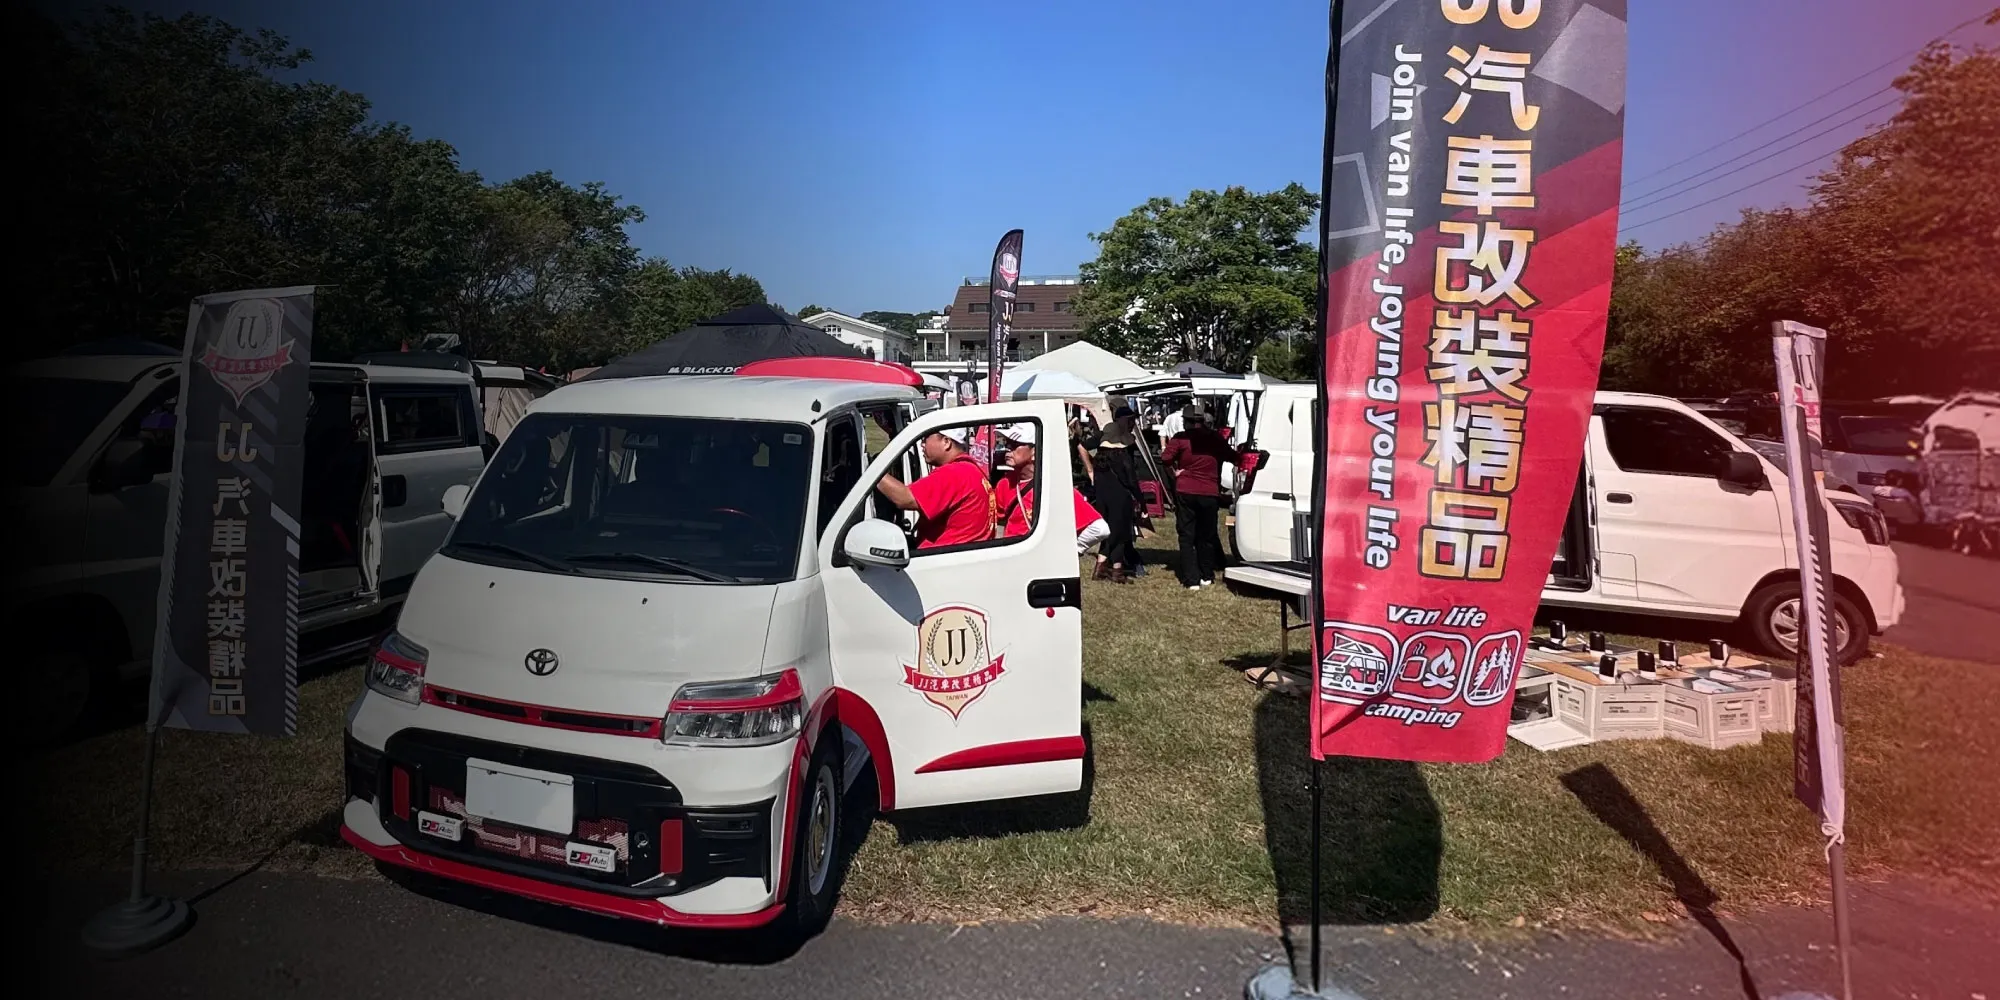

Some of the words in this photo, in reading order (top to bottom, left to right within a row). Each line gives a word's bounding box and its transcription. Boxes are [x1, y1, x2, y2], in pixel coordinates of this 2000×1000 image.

[1391, 44, 1422, 121] Join
[1387, 130, 1412, 197] van
[1421, 44, 1540, 580] 汽車改裝精品
[681, 366, 724, 374] BLACK
[1366, 407, 1395, 499] your
[1366, 507, 1397, 568] life
[1387, 605, 1441, 626] van
[1442, 606, 1487, 628] life
[941, 627, 968, 667] JJ
[945, 692, 969, 701] TAIWAN
[1364, 703, 1462, 729] camping
